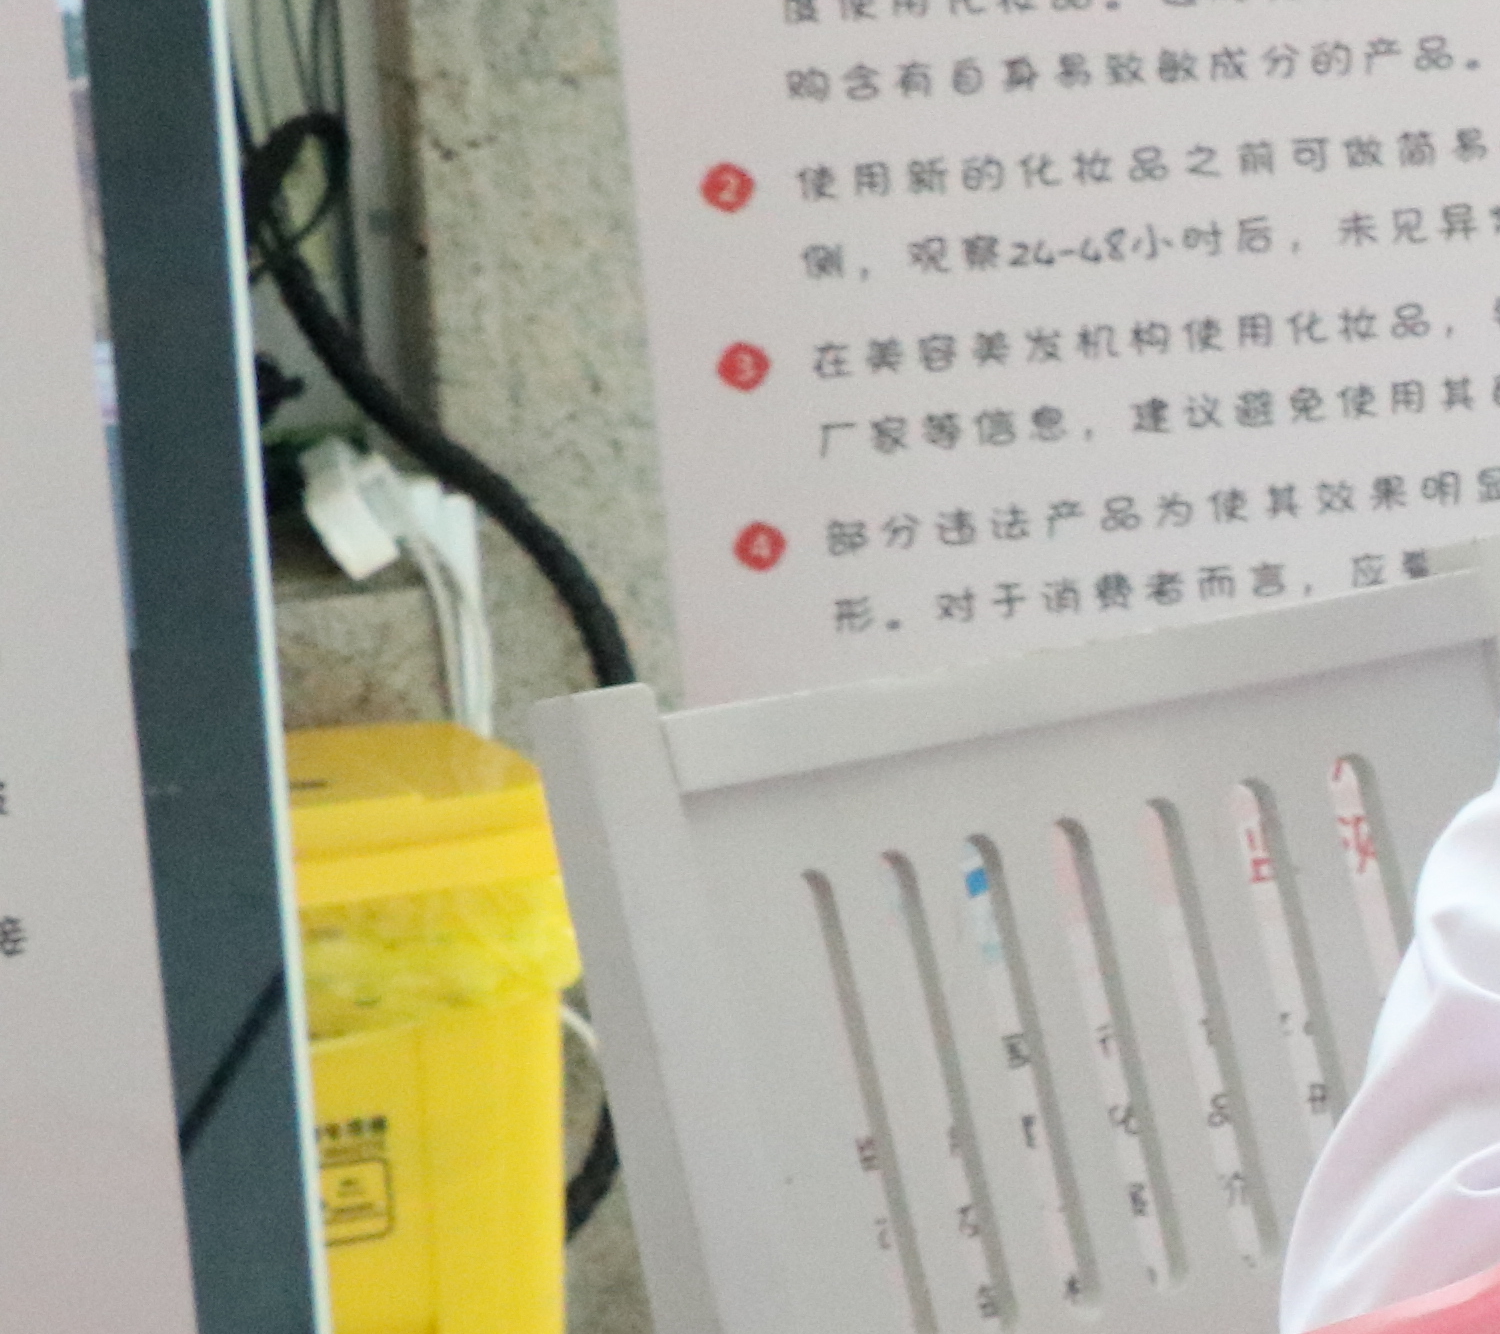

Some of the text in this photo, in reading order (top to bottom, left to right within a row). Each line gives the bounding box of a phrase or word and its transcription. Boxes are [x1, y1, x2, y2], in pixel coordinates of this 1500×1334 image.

[787, 36, 1482, 102] 购含有自身易致敏成分的产品。
